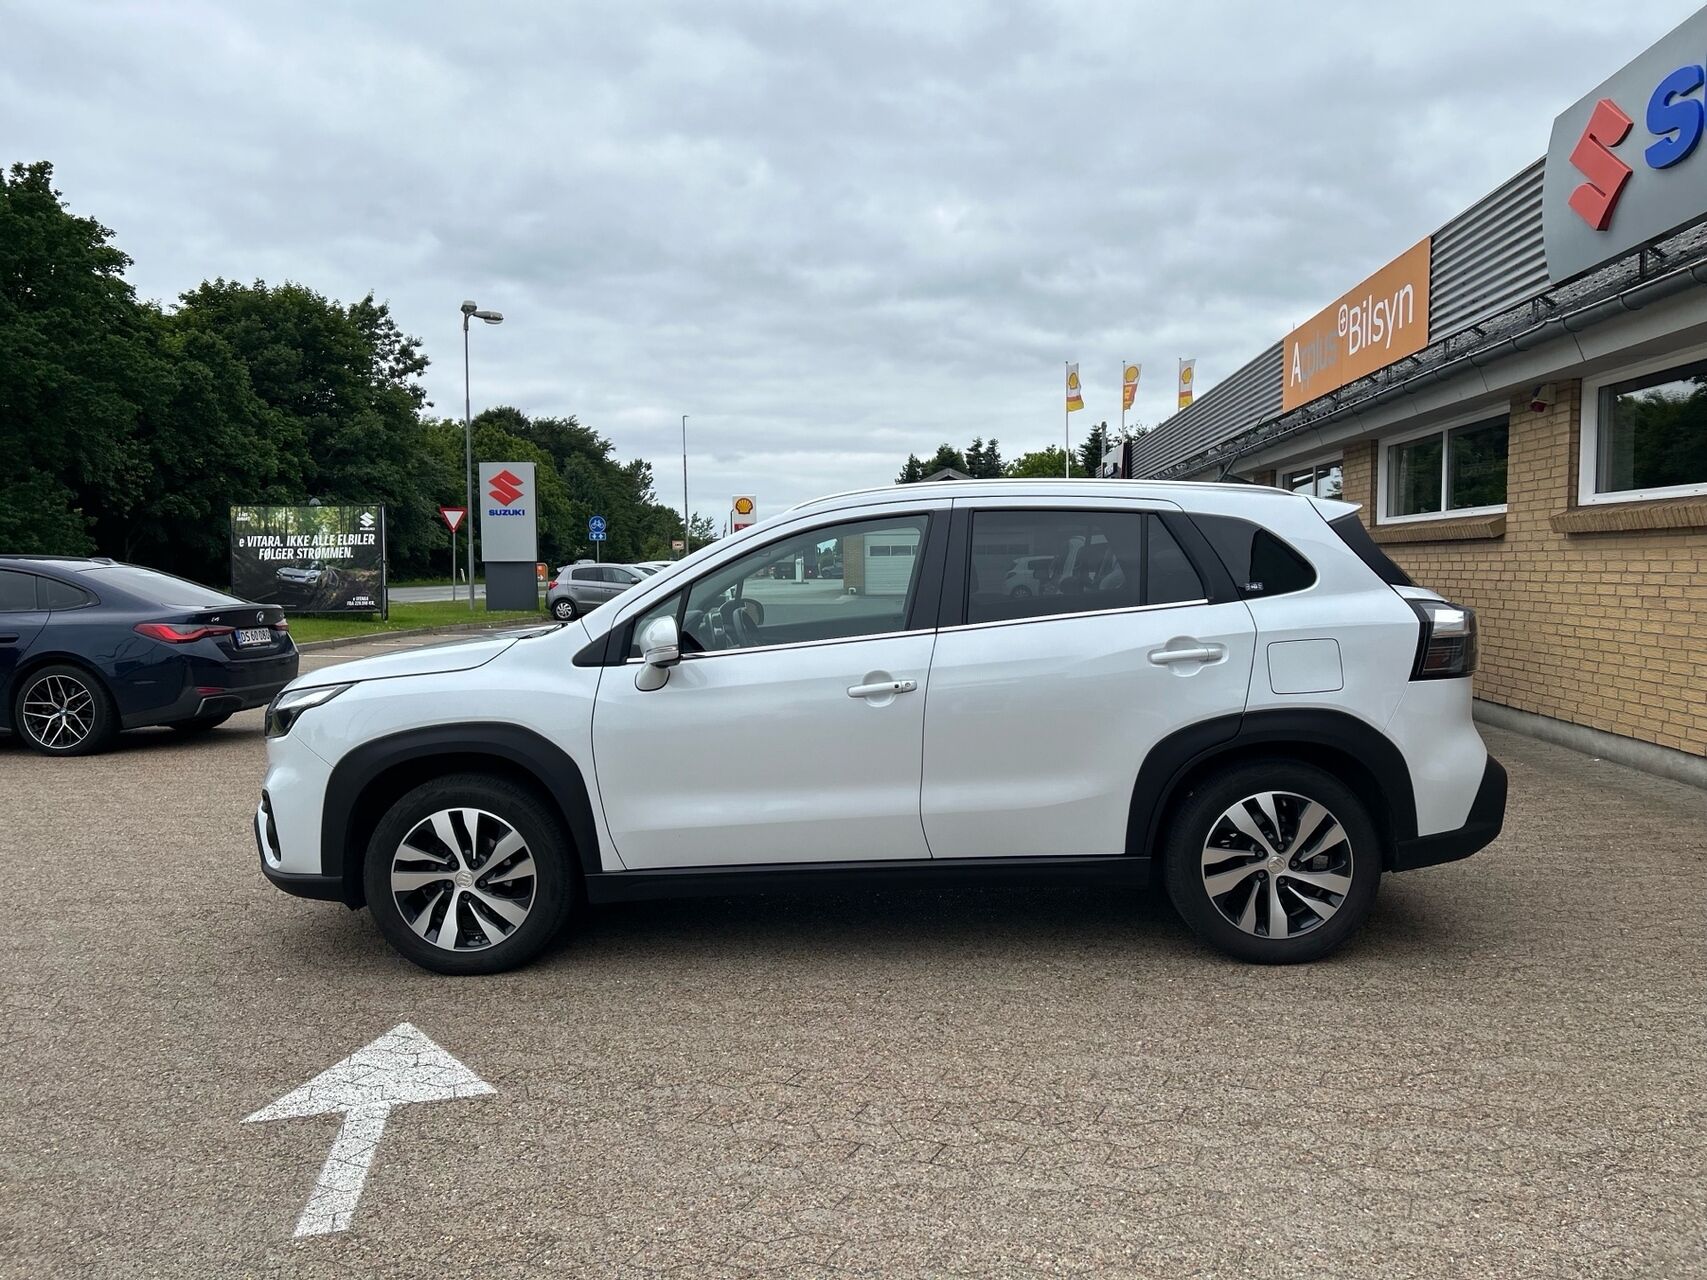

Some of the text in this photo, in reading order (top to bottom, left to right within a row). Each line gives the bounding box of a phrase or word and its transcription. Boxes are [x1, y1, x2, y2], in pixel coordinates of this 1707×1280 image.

[1349, 283, 1414, 356] Bilsyn
[239, 533, 375, 547] e VITARA. IKKE ALLE ELBILER
[259, 546, 354, 561] FØLGER STRØMMEN.
